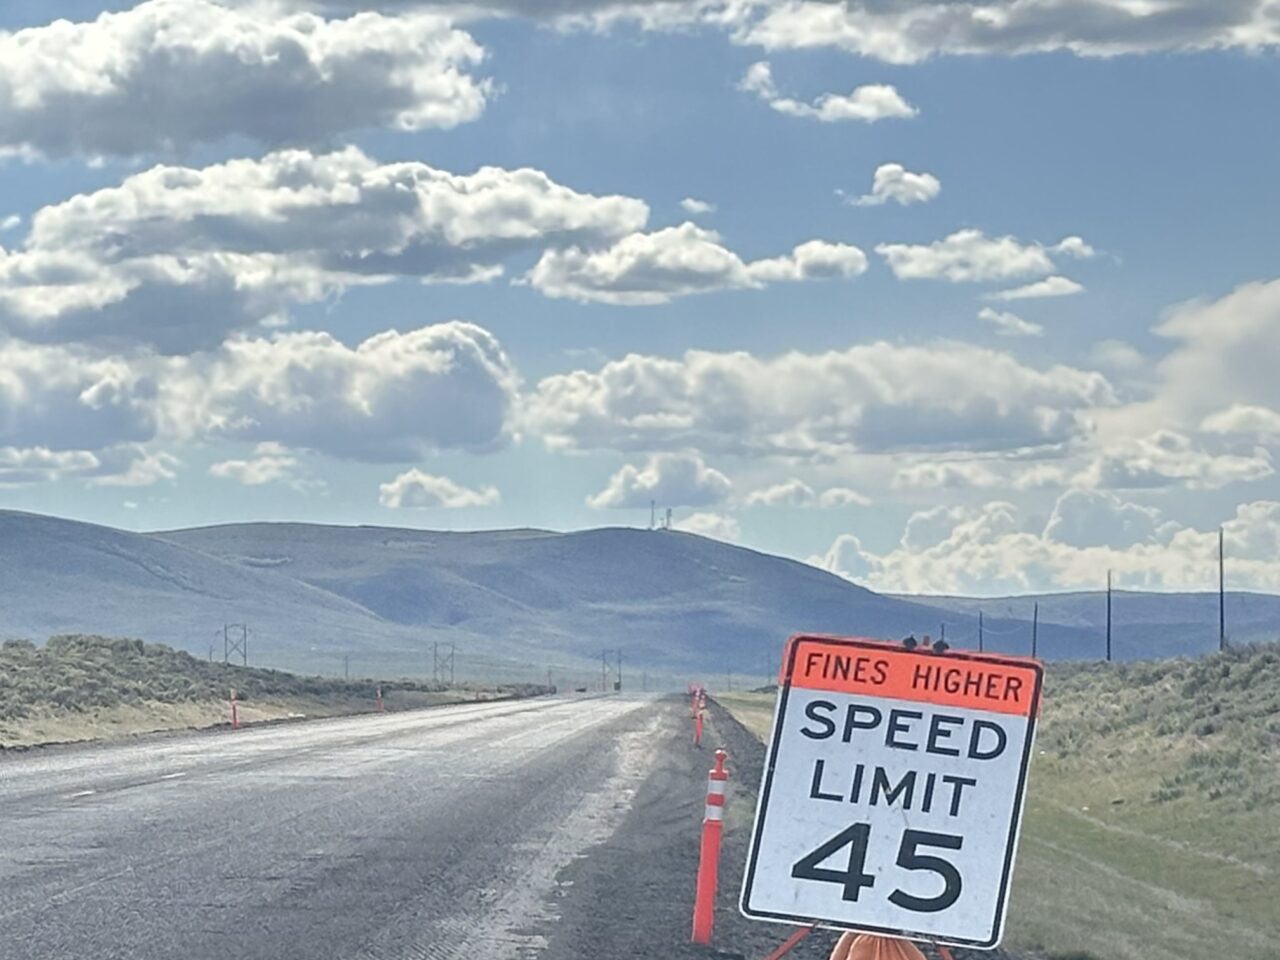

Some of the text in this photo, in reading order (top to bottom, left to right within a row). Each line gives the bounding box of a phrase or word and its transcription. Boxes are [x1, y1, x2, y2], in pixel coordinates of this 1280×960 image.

[804, 652, 1023, 702] FINES HIGHER
[800, 700, 1007, 760] SPEED
[809, 759, 977, 817] LIMIT
[791, 822, 963, 913] 45
